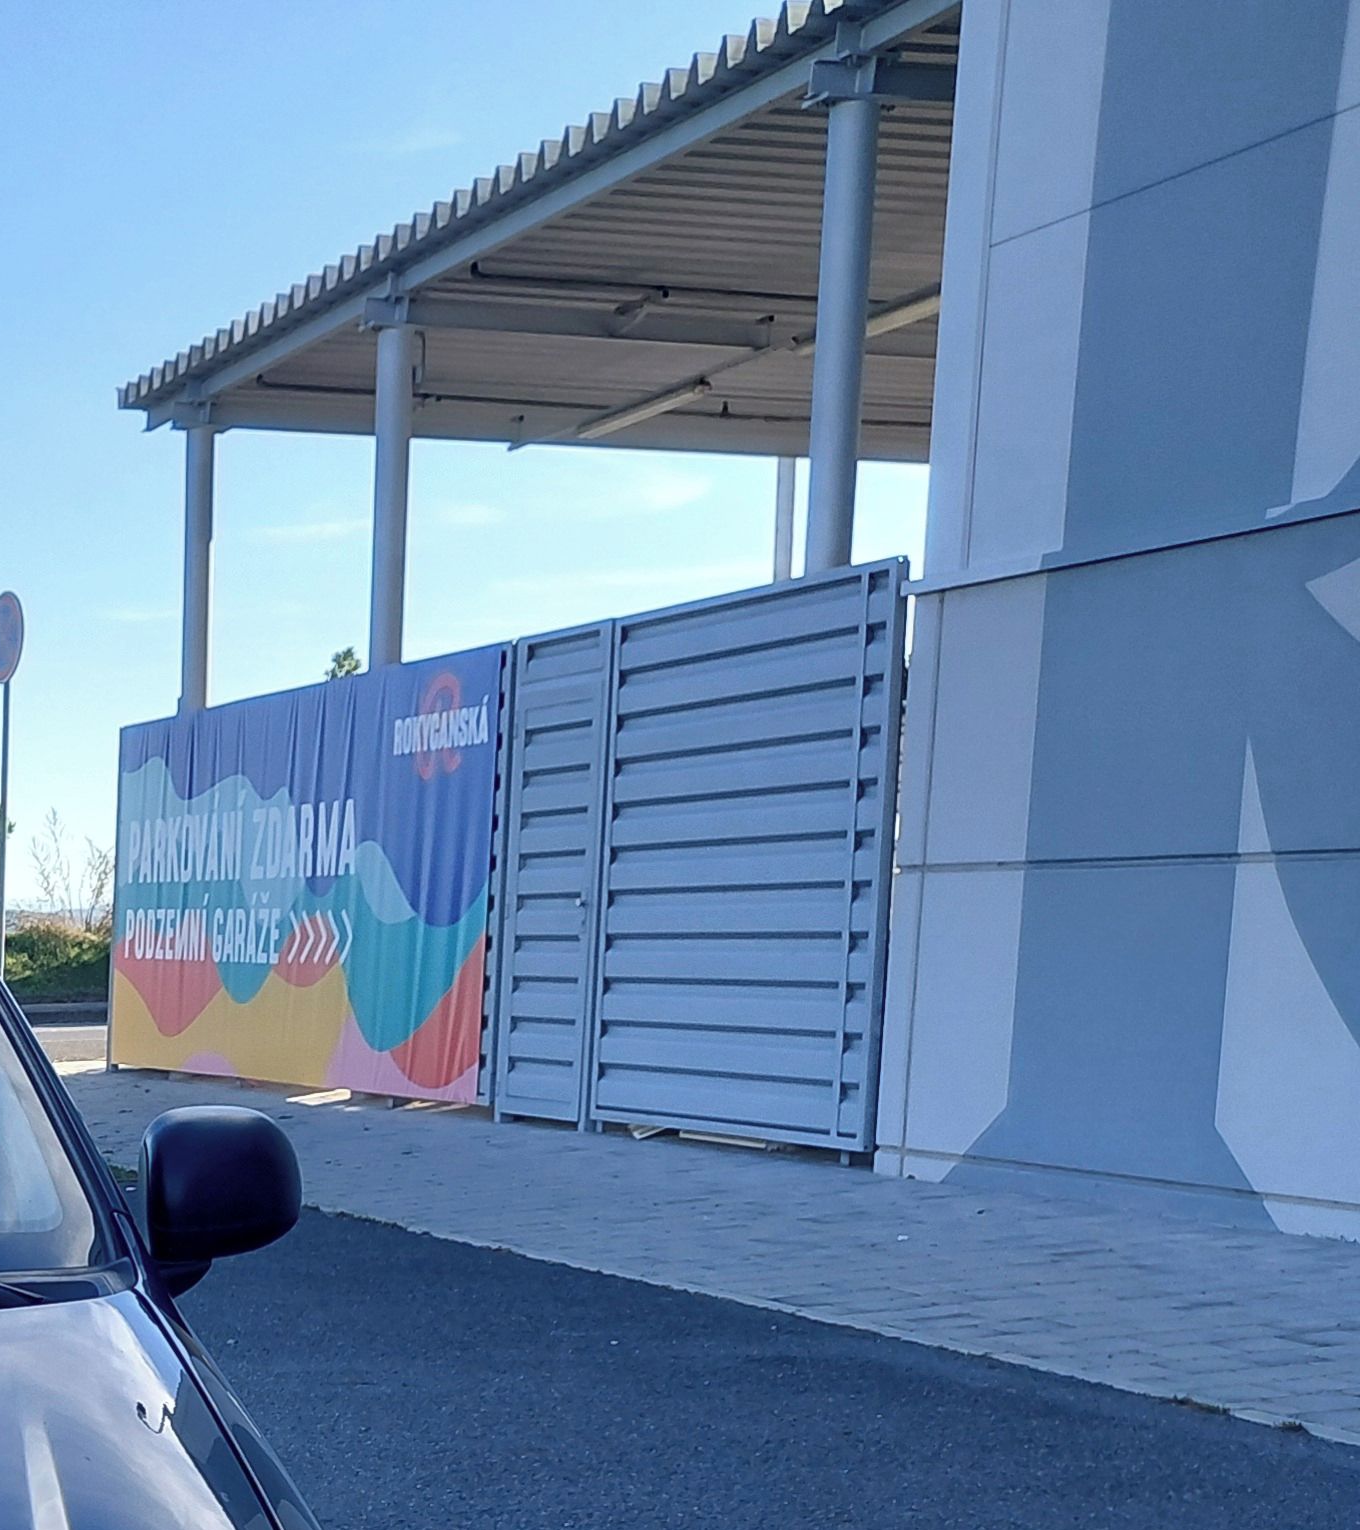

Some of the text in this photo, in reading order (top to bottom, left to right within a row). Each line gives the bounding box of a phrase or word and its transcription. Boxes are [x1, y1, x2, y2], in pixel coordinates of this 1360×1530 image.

[128, 788, 356, 884] PARKOVÁNÍ ZDARMA
[124, 890, 280, 965] PODZEMNÍ GARÁŽE
